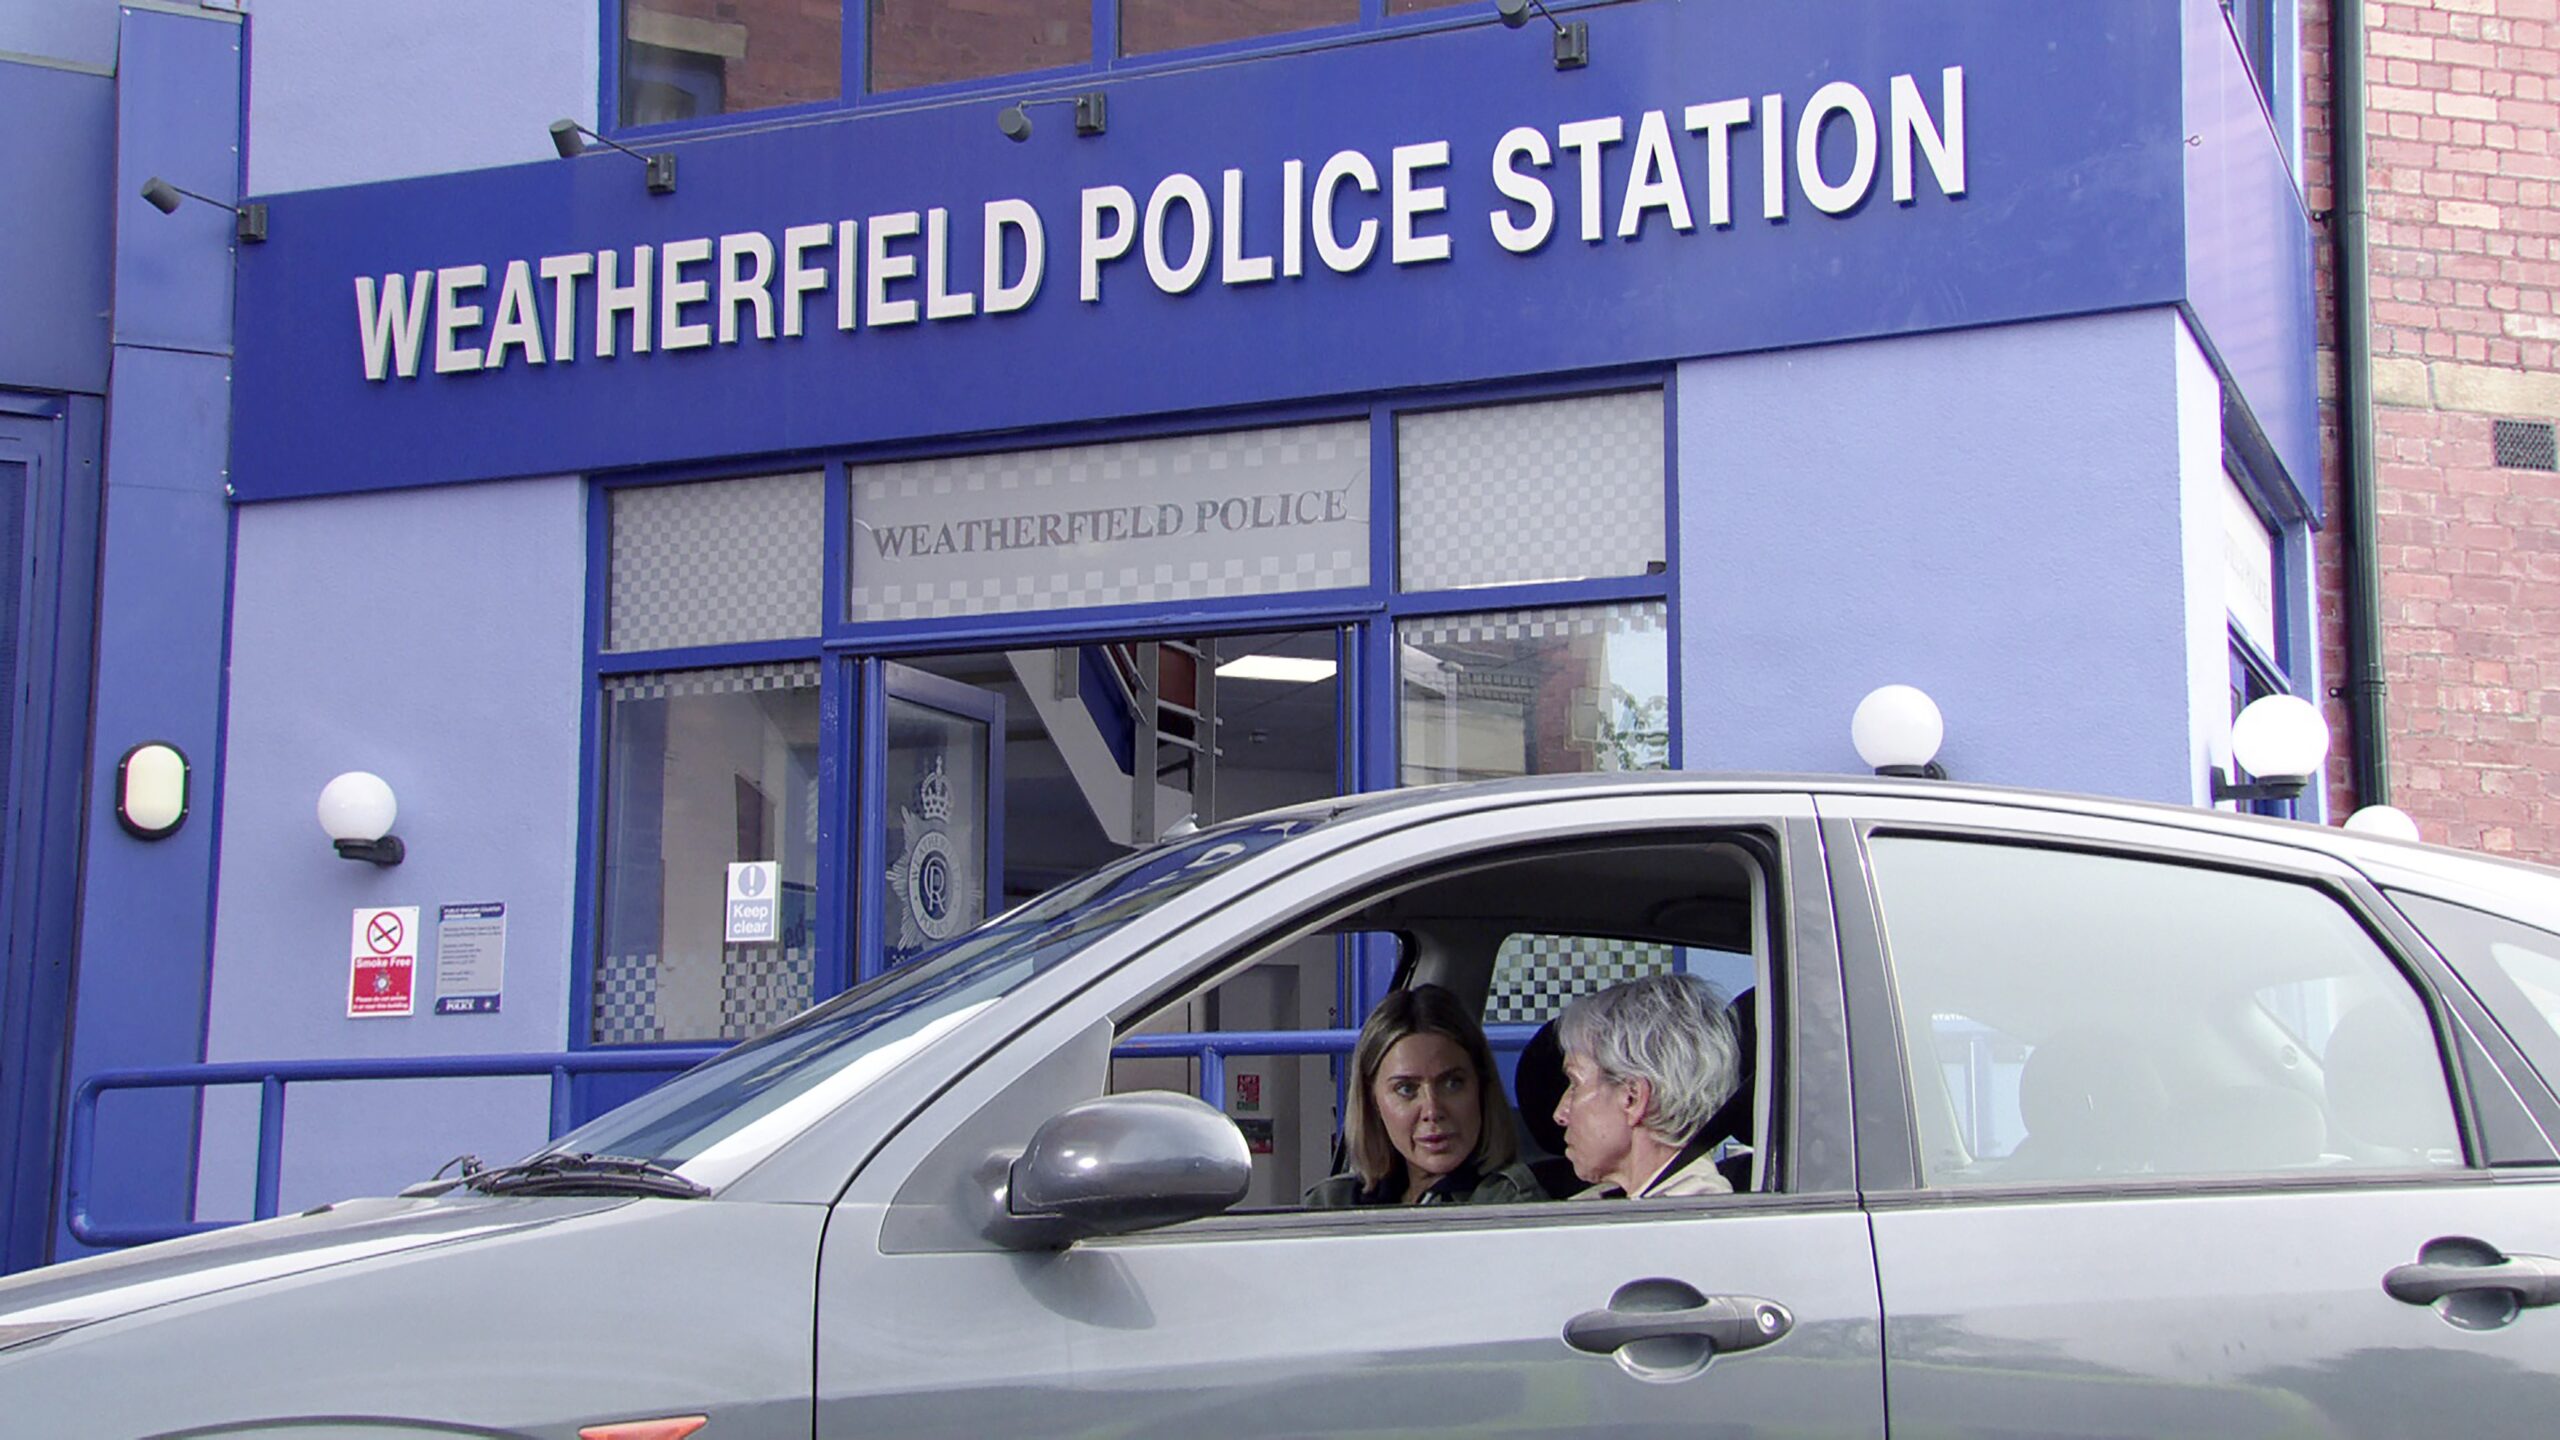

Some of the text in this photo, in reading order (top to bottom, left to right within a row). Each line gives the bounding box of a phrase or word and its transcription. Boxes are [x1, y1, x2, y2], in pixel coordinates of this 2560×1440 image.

[355, 65, 1967, 382] WEATHERFIELD POLICE STATION
[872, 488, 1350, 558] WEATHERFIELD POLICE
[733, 903, 769, 921] Keep
[733, 920, 769, 934] clear
[356, 957, 412, 969] Smoke Free
